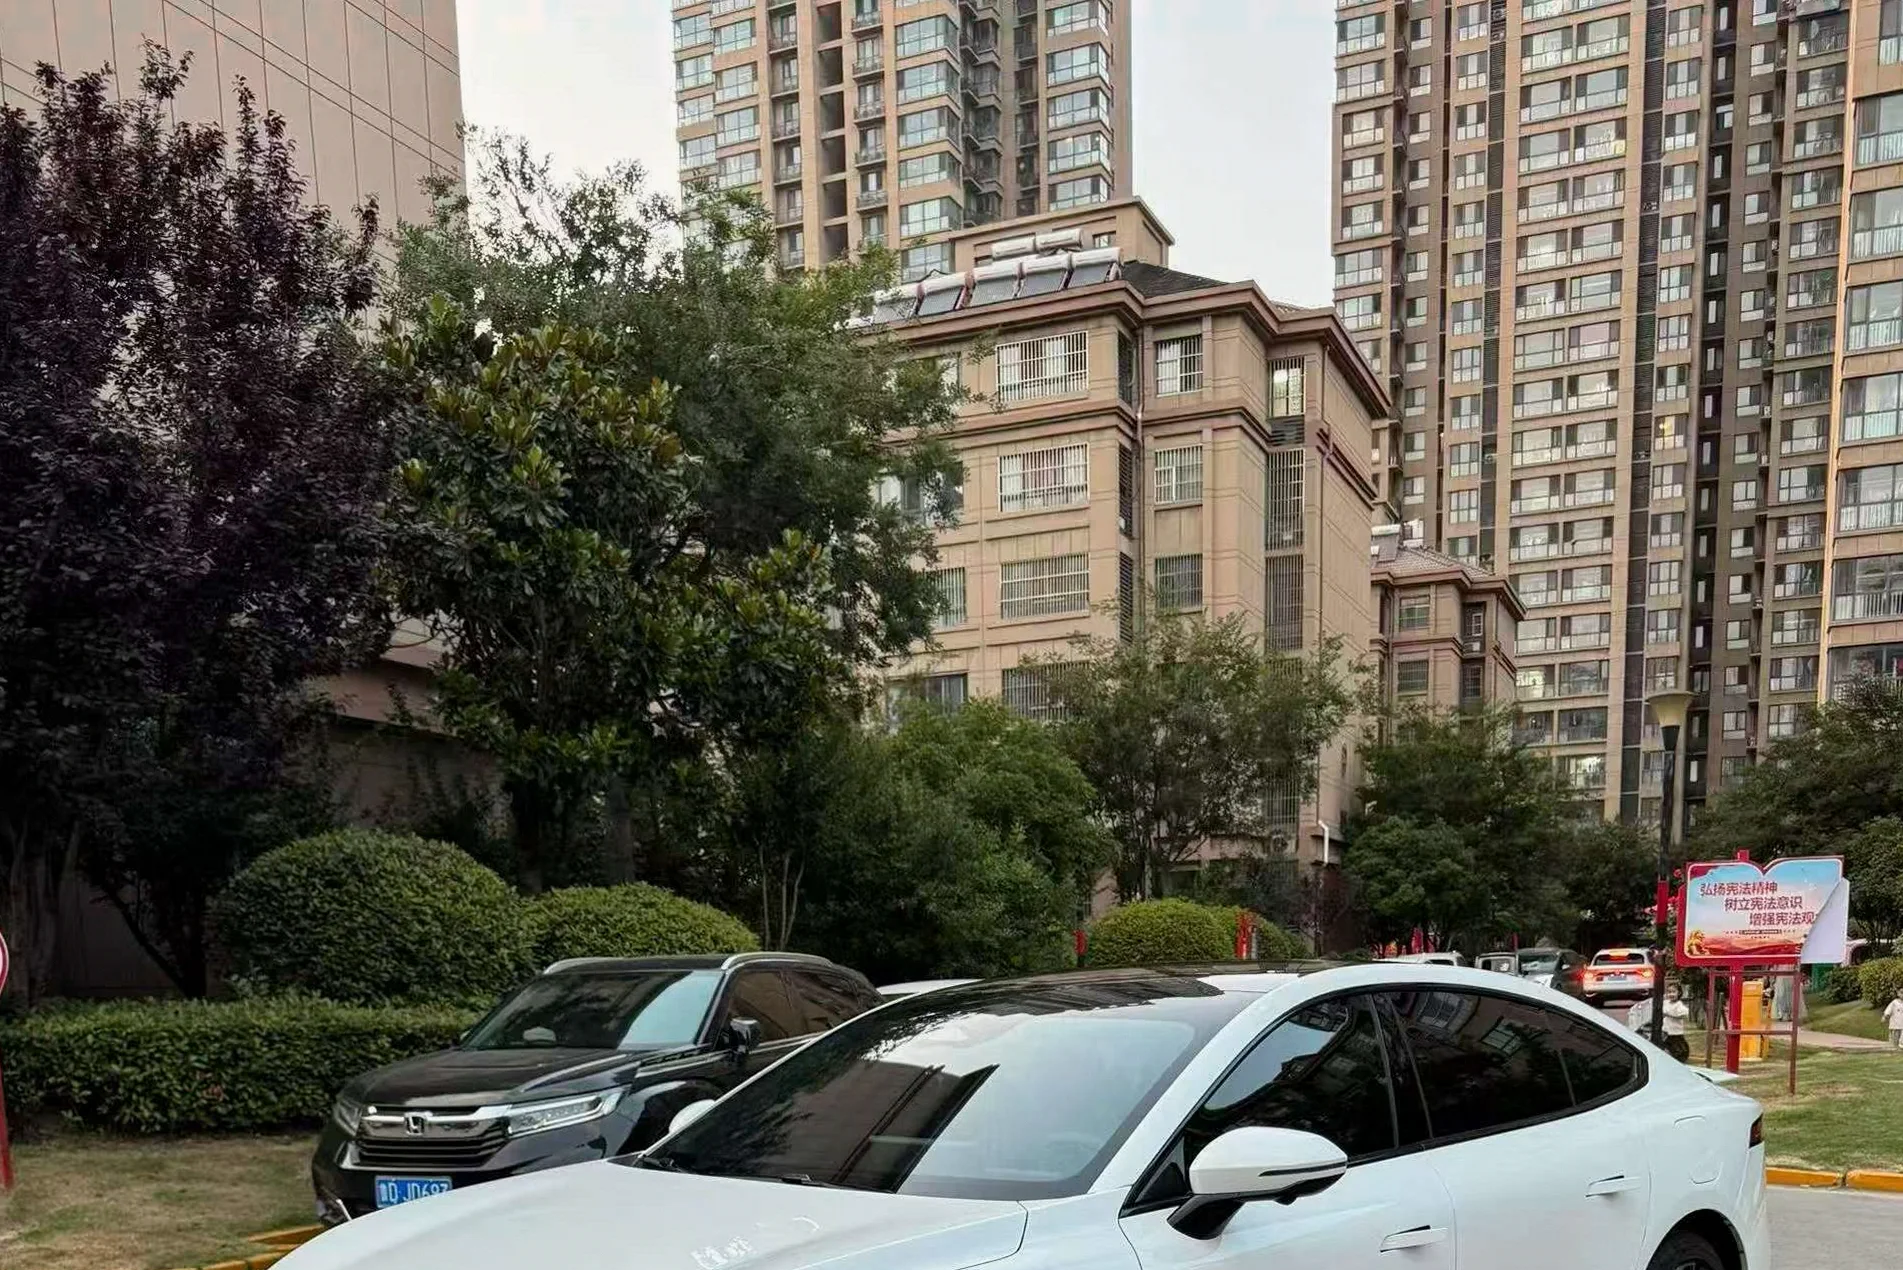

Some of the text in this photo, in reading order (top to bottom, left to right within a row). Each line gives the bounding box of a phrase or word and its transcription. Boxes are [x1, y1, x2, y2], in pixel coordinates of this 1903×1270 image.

[1700, 881, 1778, 897] 弘扬宪法精神
[1724, 895, 1803, 912] 树立宪法意识
[1749, 911, 1818, 926] 增强宪法观
